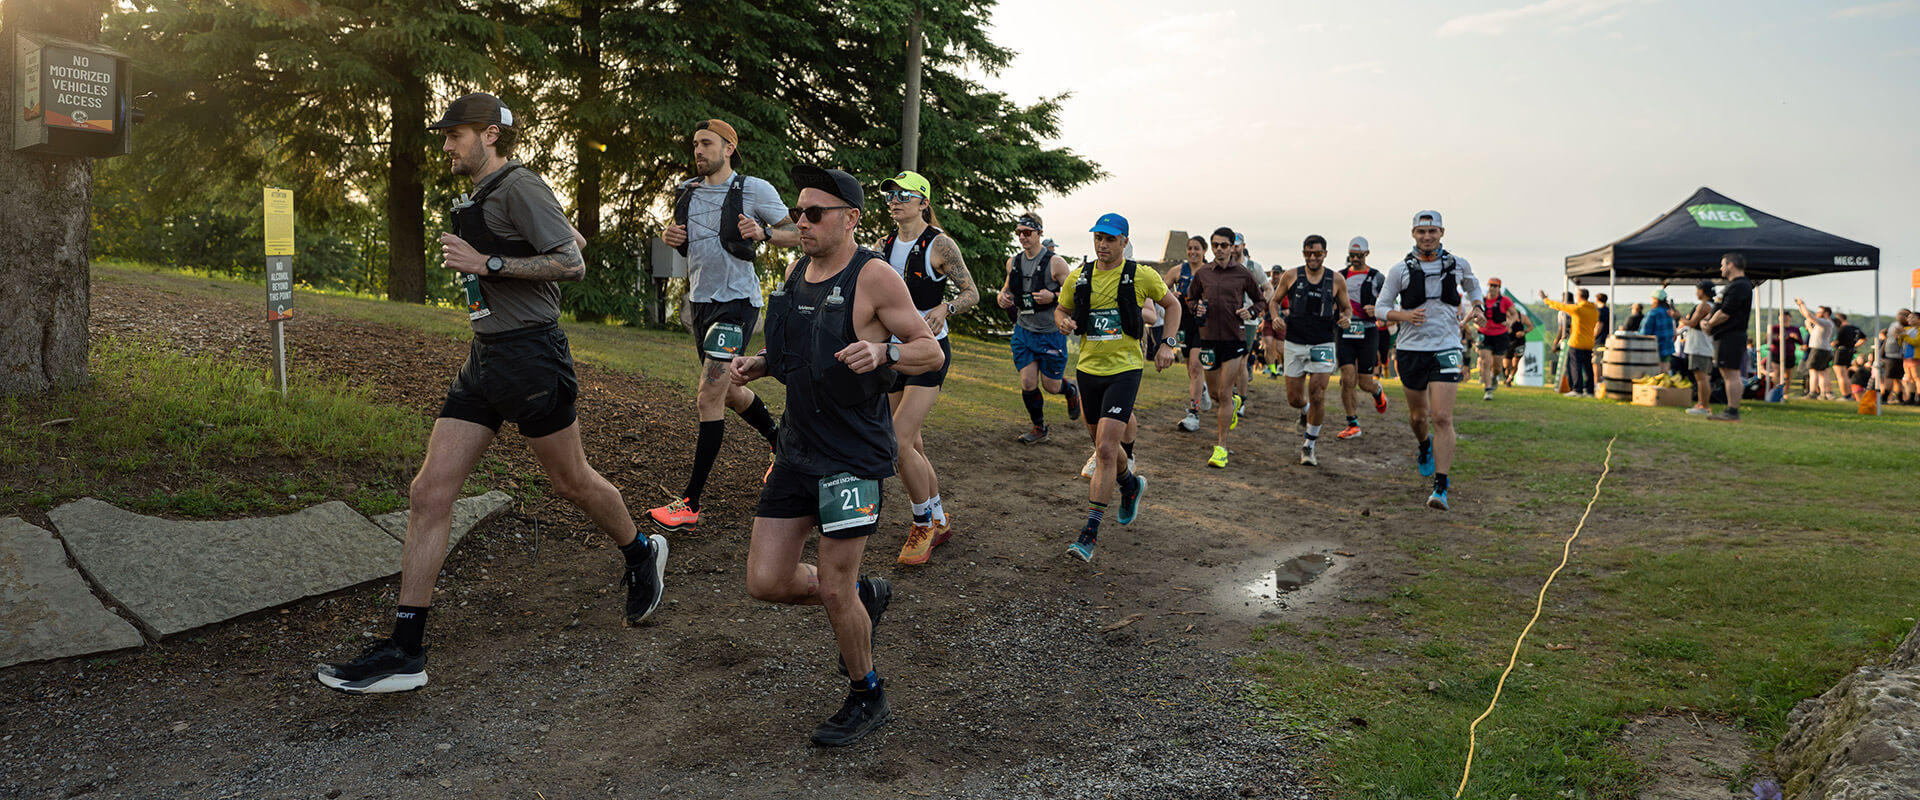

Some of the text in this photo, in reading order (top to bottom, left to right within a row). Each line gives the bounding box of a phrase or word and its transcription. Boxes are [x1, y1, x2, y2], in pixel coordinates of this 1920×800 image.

[73, 55, 89, 67] NO
[49, 65, 110, 83] MOTORIZED
[52, 79, 108, 96] VEHICLES
[57, 93, 102, 108] ACCESS
[1697, 210, 1745, 222] MEC
[276, 261, 283, 271] NO
[1833, 255, 1870, 266] MEC.CA
[271, 272, 289, 281] ALCOHOL
[272, 281, 289, 291] BEYOND
[269, 291, 292, 301] THIS POINT
[1094, 317, 1110, 330] 42
[717, 333, 726, 347] 6
[1320, 351, 1326, 360] 2
[840, 487, 861, 510] 21
